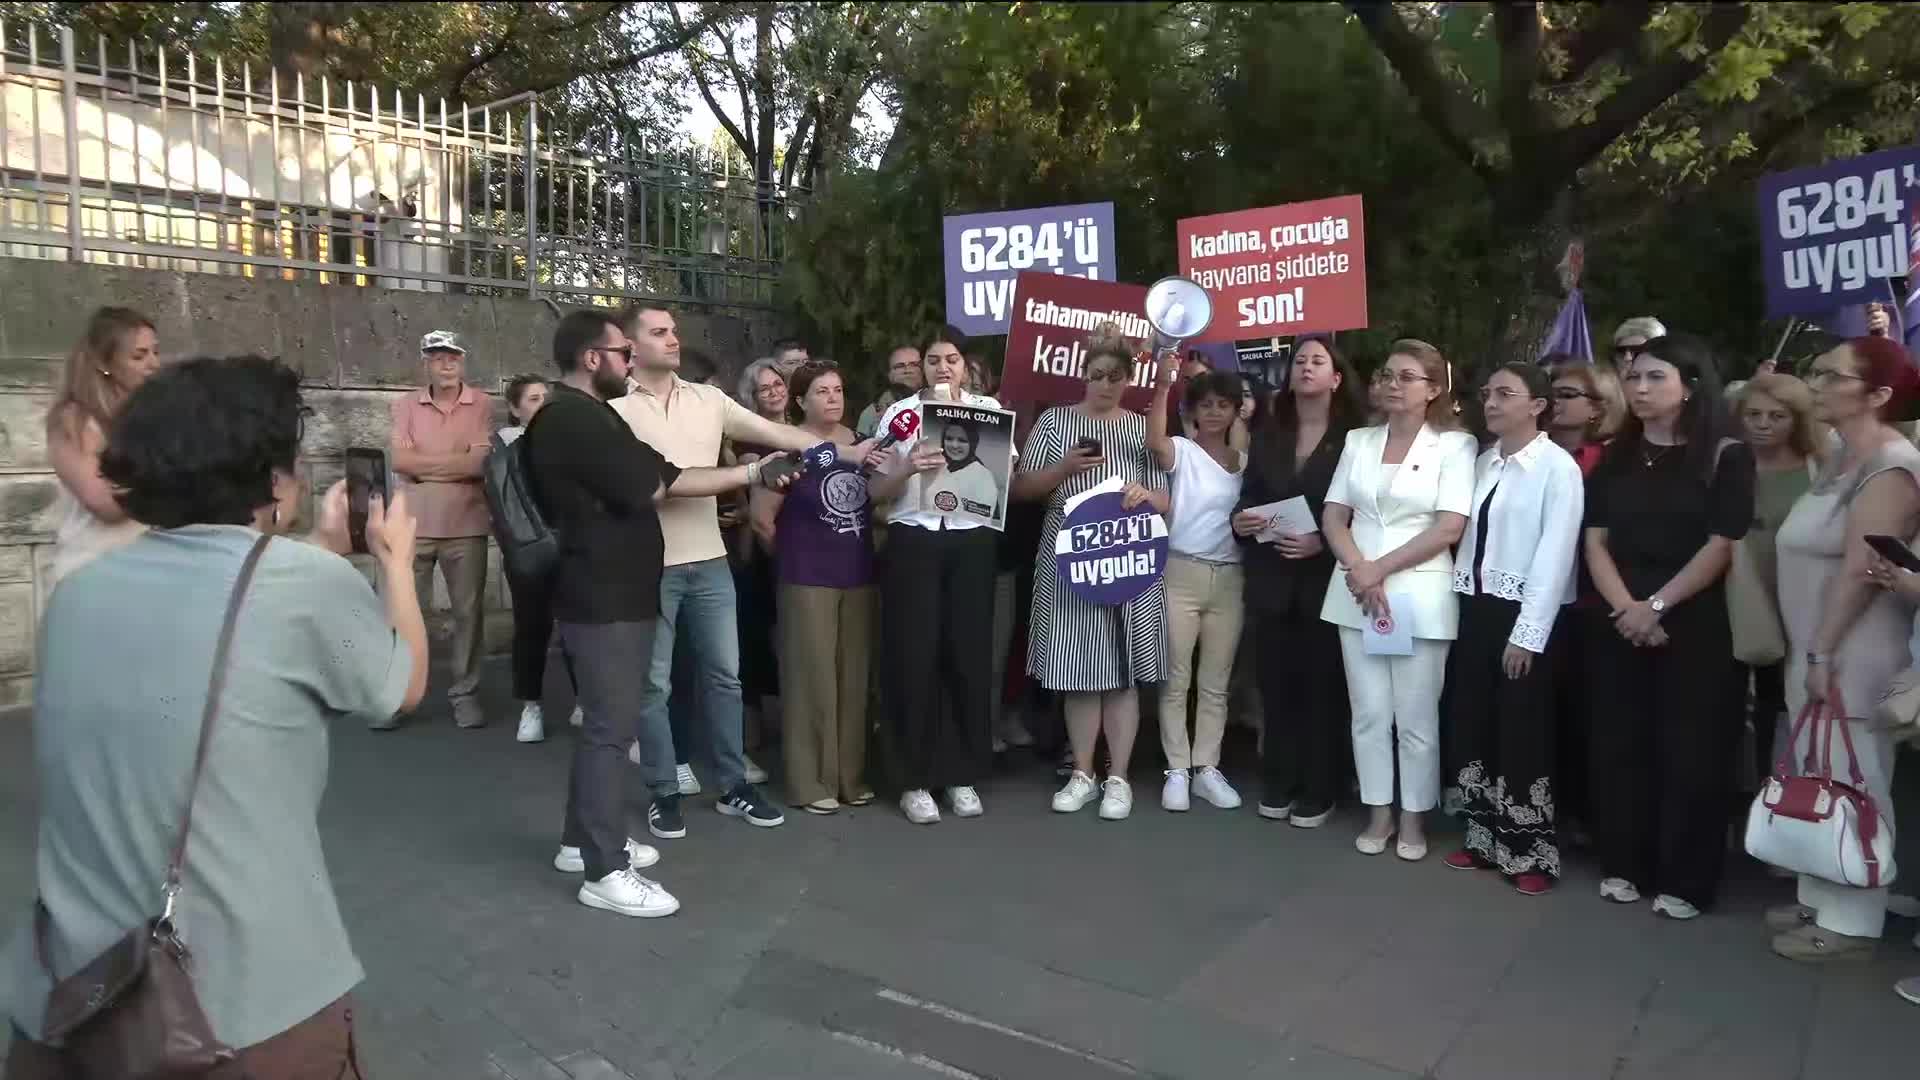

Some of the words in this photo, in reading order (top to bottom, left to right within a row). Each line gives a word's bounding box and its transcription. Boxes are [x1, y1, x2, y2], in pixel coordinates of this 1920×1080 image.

[961, 217, 1098, 272] 6284'ü
[1191, 229, 1266, 258] kadına,
[1271, 216, 1349, 252] çocuğa
[1276, 252, 1349, 283] şiddete
[1783, 223, 1909, 293] uygul
[1238, 287, 1304, 327] son!
[973, 412, 1000, 425] OZAN
[1070, 513, 1152, 553] 6284'ü
[1070, 549, 1156, 586] uygula!
